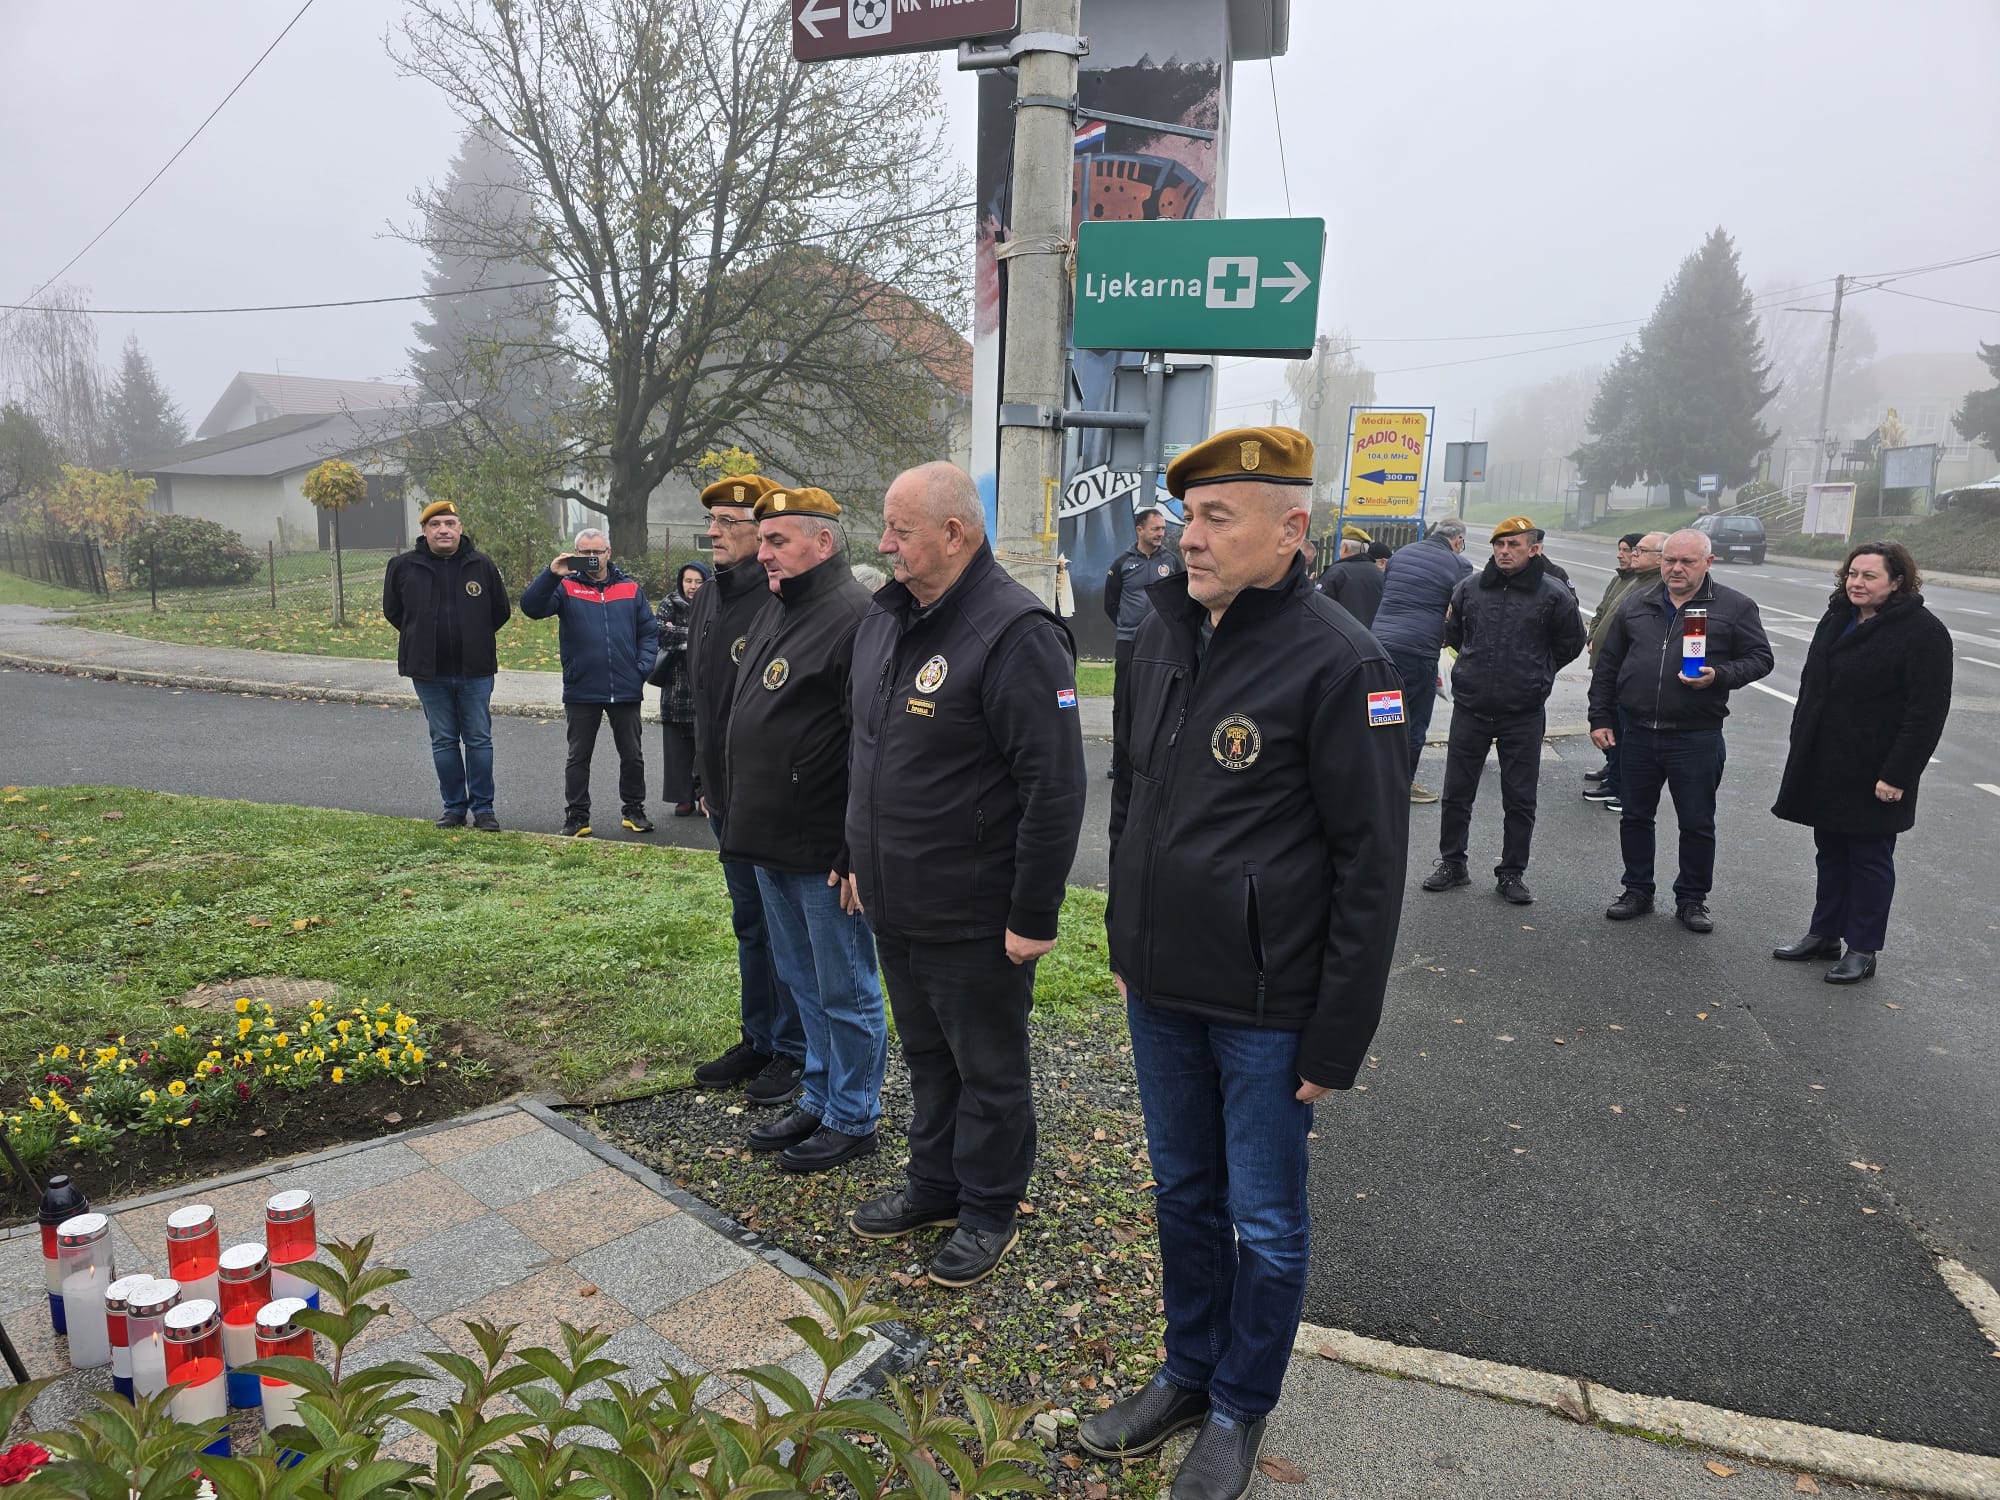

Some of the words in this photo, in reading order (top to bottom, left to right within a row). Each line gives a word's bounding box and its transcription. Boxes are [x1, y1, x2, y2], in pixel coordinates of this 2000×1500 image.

[1085, 272, 1202, 303] Ljekarna
[1361, 417, 1392, 425] Media
[1401, 416, 1421, 425] Mix
[1356, 430, 1398, 453] RADIO
[1401, 434, 1421, 456] 105
[1373, 714, 1402, 723] CROATIA
